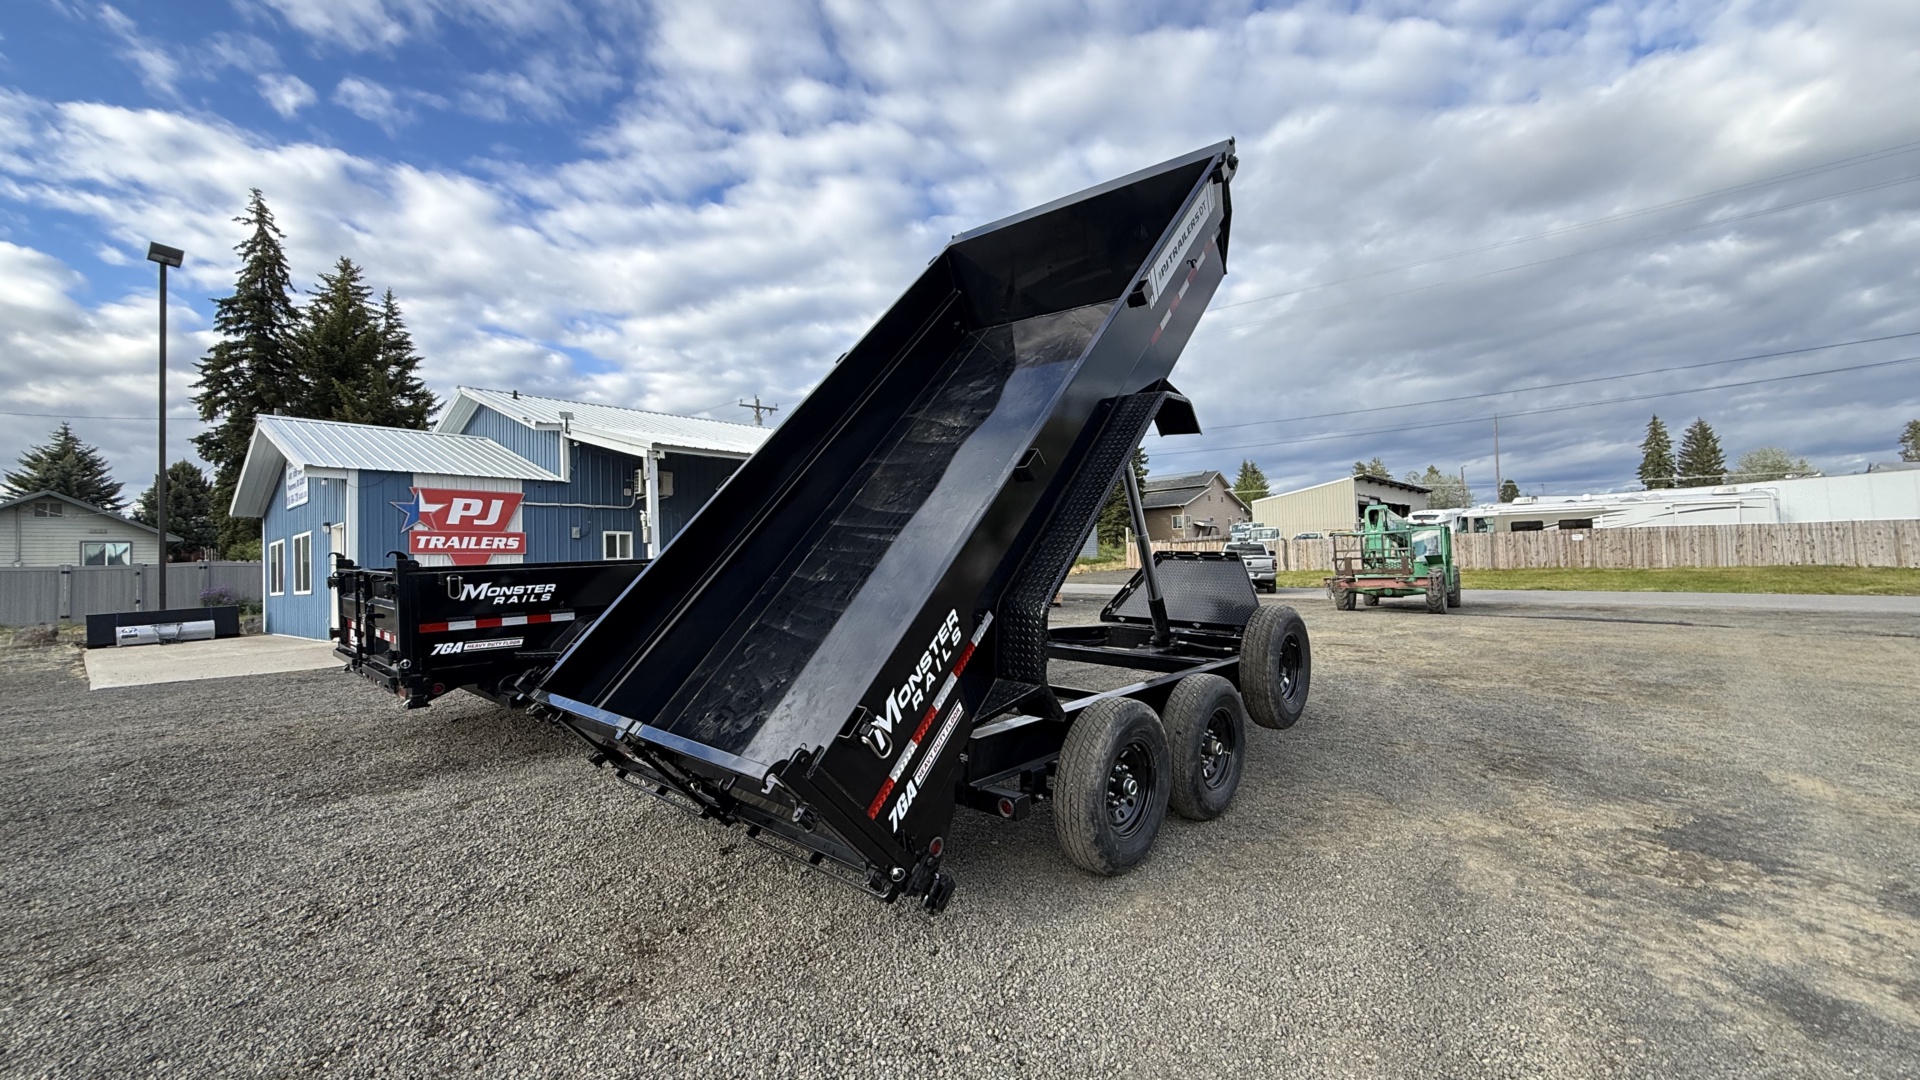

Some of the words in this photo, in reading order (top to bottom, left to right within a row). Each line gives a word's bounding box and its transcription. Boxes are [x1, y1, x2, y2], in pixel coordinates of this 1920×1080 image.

[1167, 212, 1200, 263] TRAILERS
[446, 497, 504, 525] PJ
[416, 536, 520, 550] TRAILERS
[460, 582, 556, 601] MONSTER
[493, 593, 552, 605] RAILS
[430, 642, 464, 656] 7GA
[874, 608, 959, 751] MONSTER
[912, 626, 961, 711] RAILS
[888, 779, 918, 833] 7GA
[917, 753, 935, 780] HEAVY
[933, 732, 947, 754] DUTY
[945, 707, 961, 733] FLOOR
